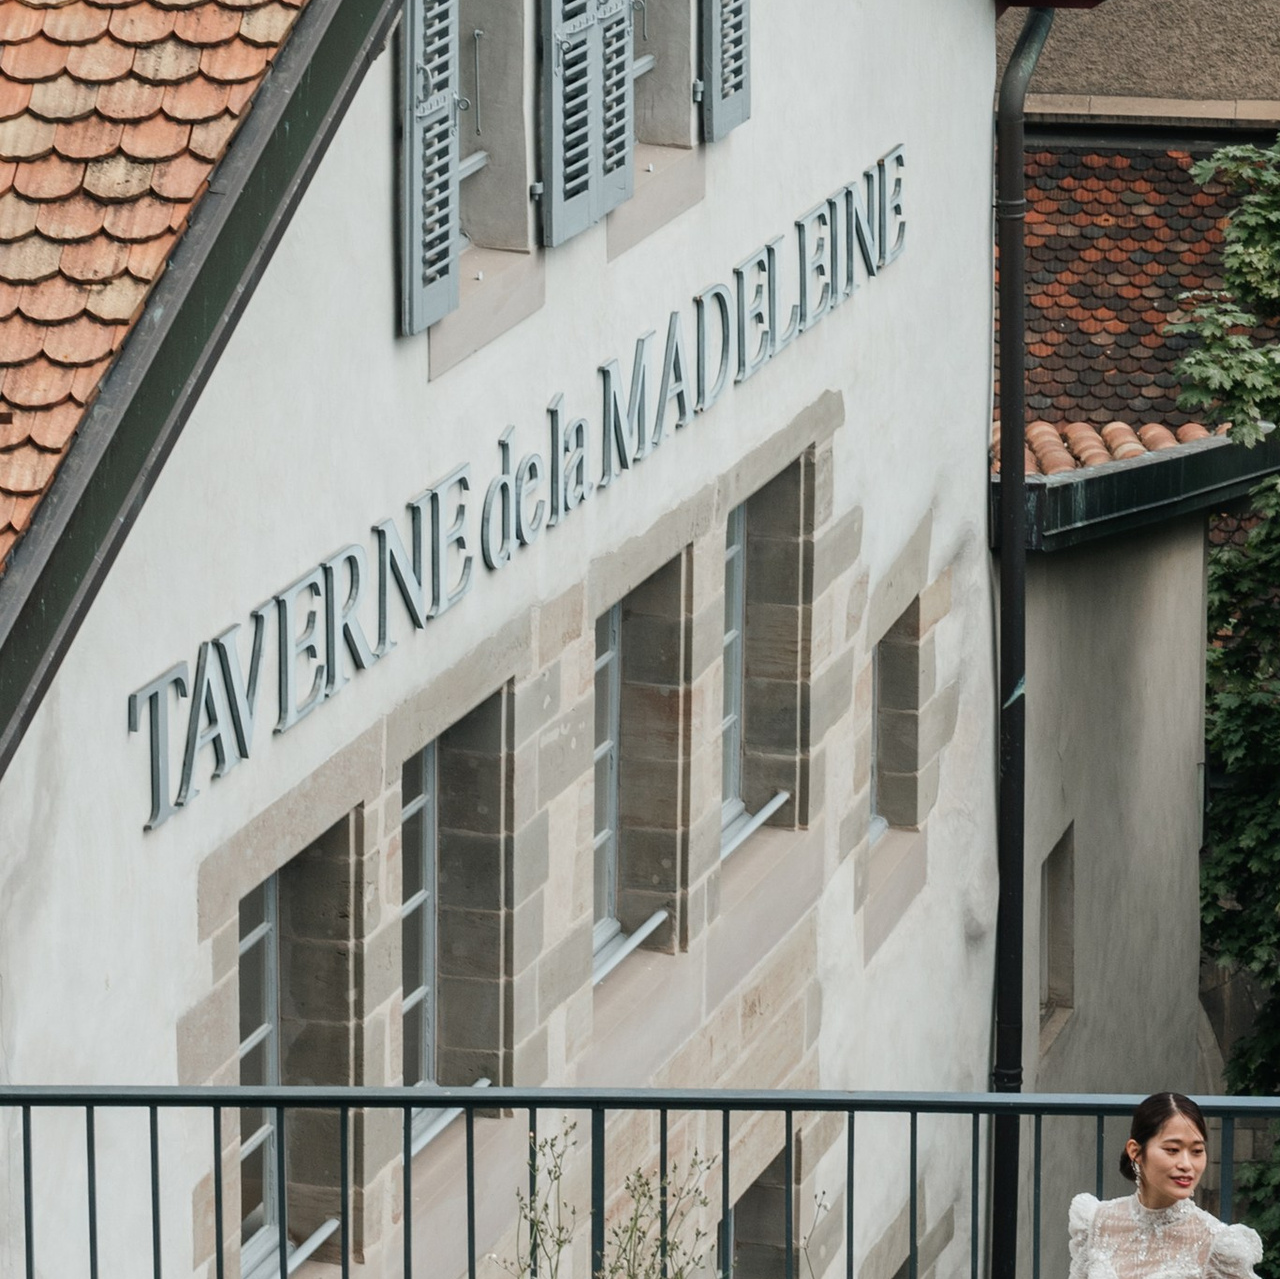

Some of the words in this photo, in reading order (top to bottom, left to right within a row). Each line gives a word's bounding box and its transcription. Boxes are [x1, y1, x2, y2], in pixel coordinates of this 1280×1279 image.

[128, 462, 475, 832] TAVERNE
[481, 425, 546, 571] de
[546, 392, 593, 529] la
[598, 143, 908, 489] MADELEINE
